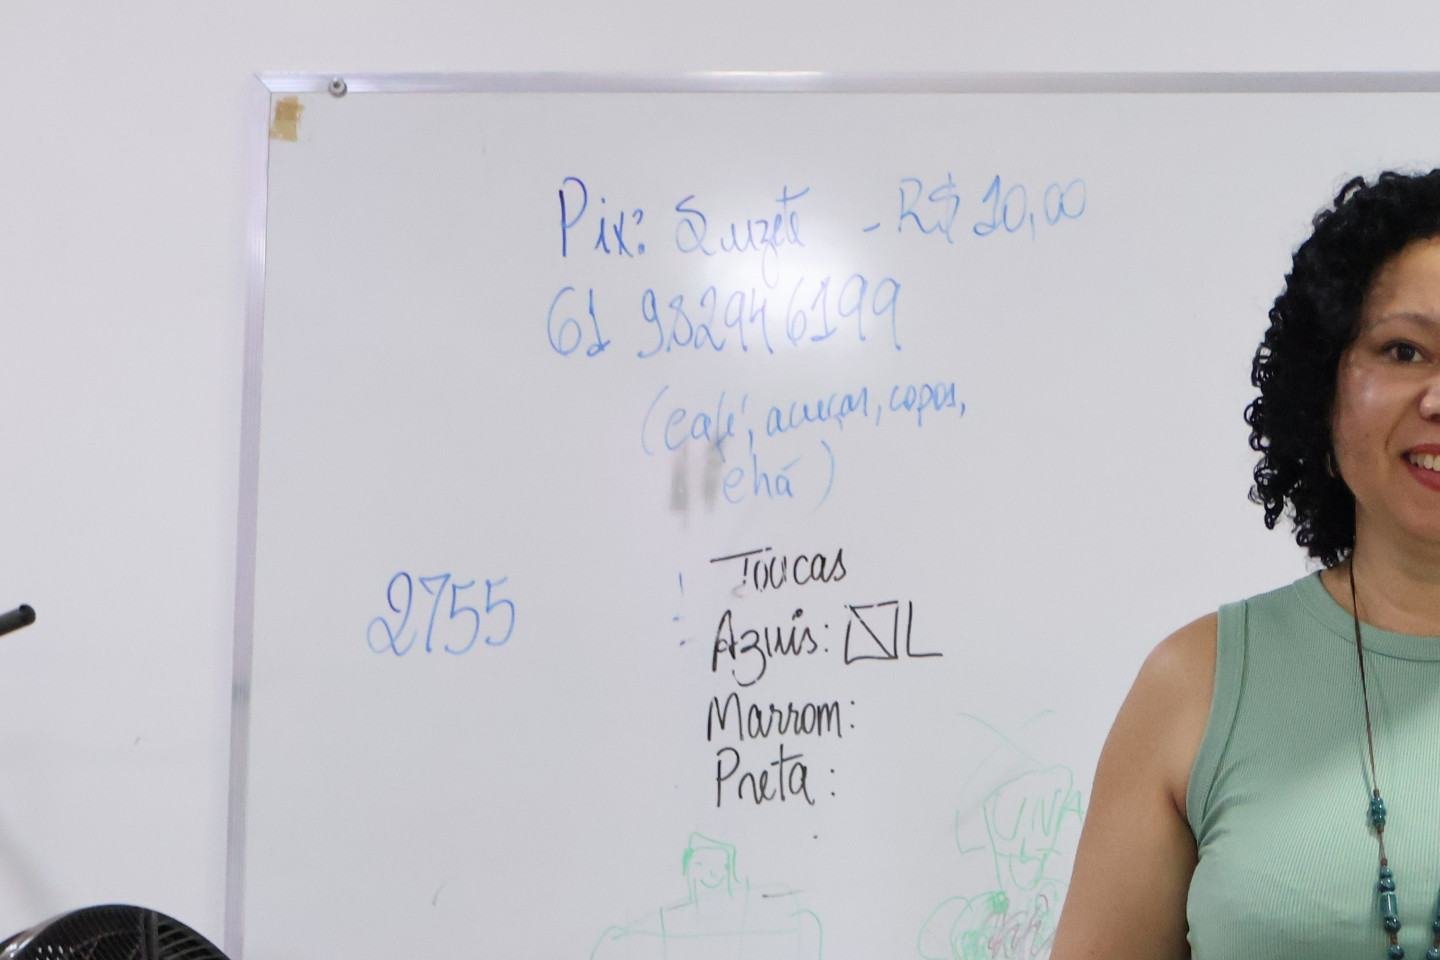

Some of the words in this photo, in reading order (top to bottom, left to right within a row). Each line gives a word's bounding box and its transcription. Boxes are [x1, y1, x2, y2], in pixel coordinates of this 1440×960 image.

[710, 546, 847, 592] Toucas
[366, 571, 516, 657] 2755
[707, 692, 855, 742] Marrom:
